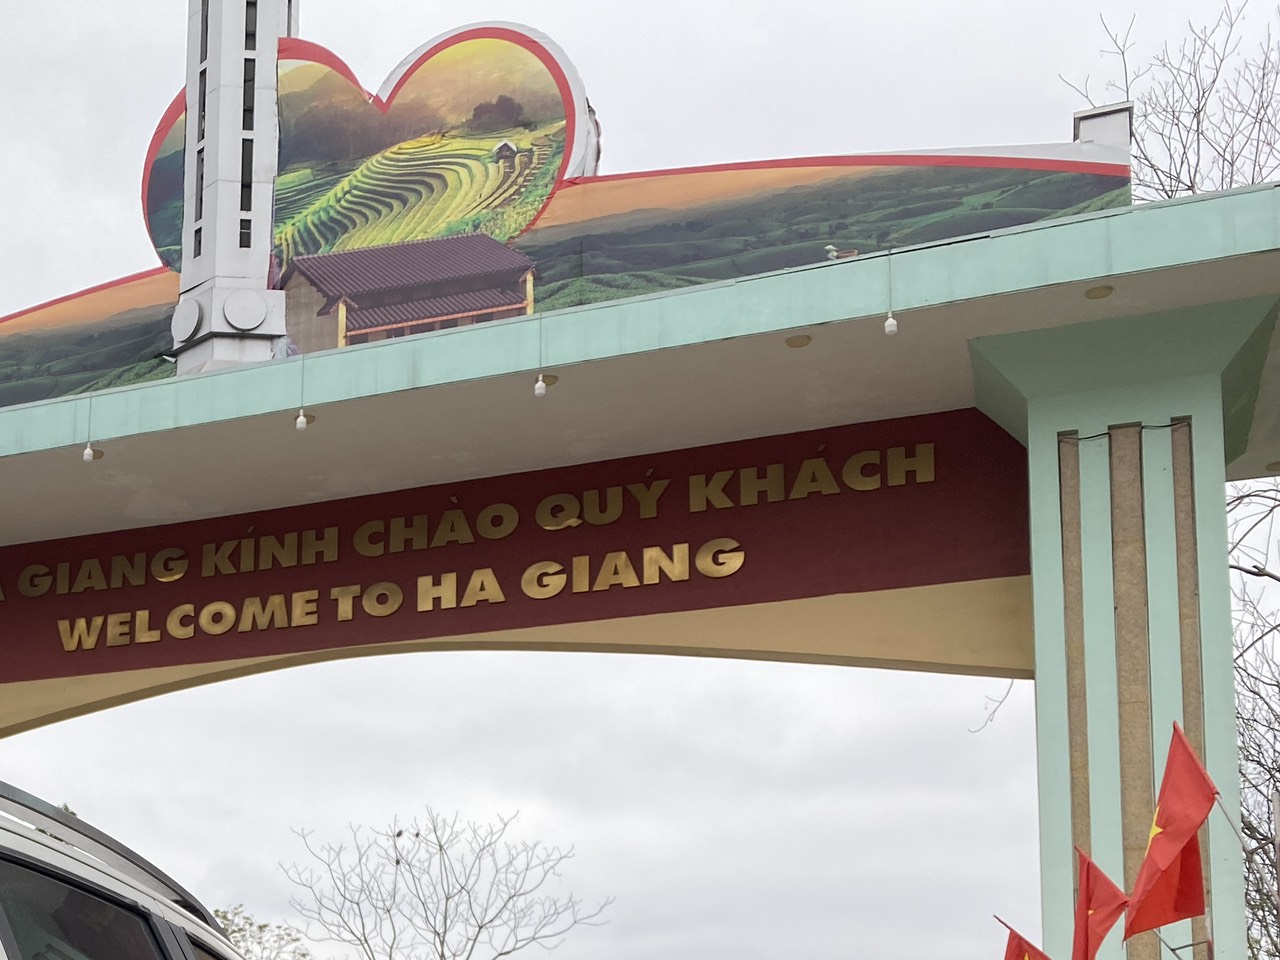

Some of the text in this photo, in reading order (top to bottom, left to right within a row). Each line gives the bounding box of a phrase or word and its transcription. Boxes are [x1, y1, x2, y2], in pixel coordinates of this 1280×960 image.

[17, 547, 190, 598] GIANG
[201, 526, 339, 578] KÍNH
[353, 496, 519, 558] CHÀO
[534, 469, 671, 531] QUÝ
[689, 443, 936, 514] KHÁCH
[57, 537, 745, 652] WELCOME TO HA GIANG
